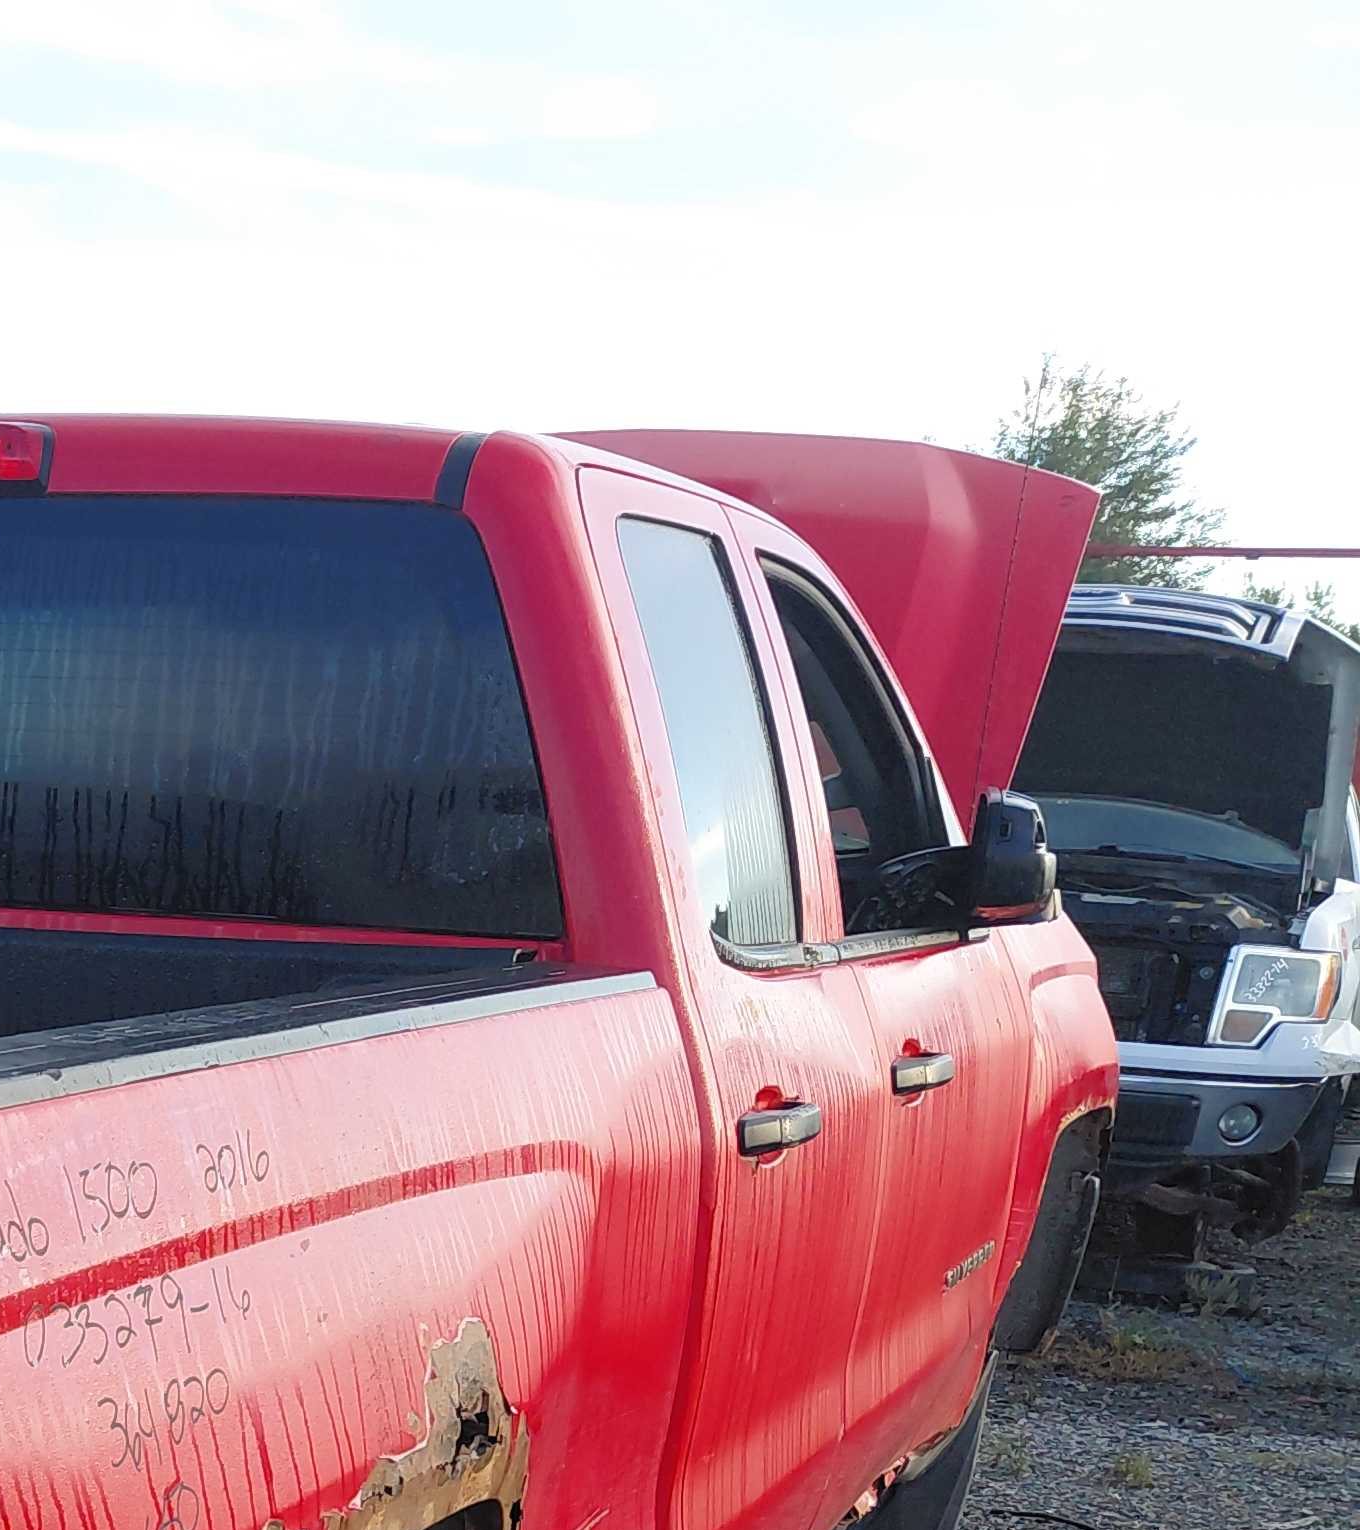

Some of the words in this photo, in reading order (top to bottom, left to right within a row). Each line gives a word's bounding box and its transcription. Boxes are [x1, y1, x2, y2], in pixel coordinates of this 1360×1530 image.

[62, 1159, 158, 1243] 1500
[196, 1129, 270, 1194] 2016
[23, 1265, 251, 1369] 033279-16
